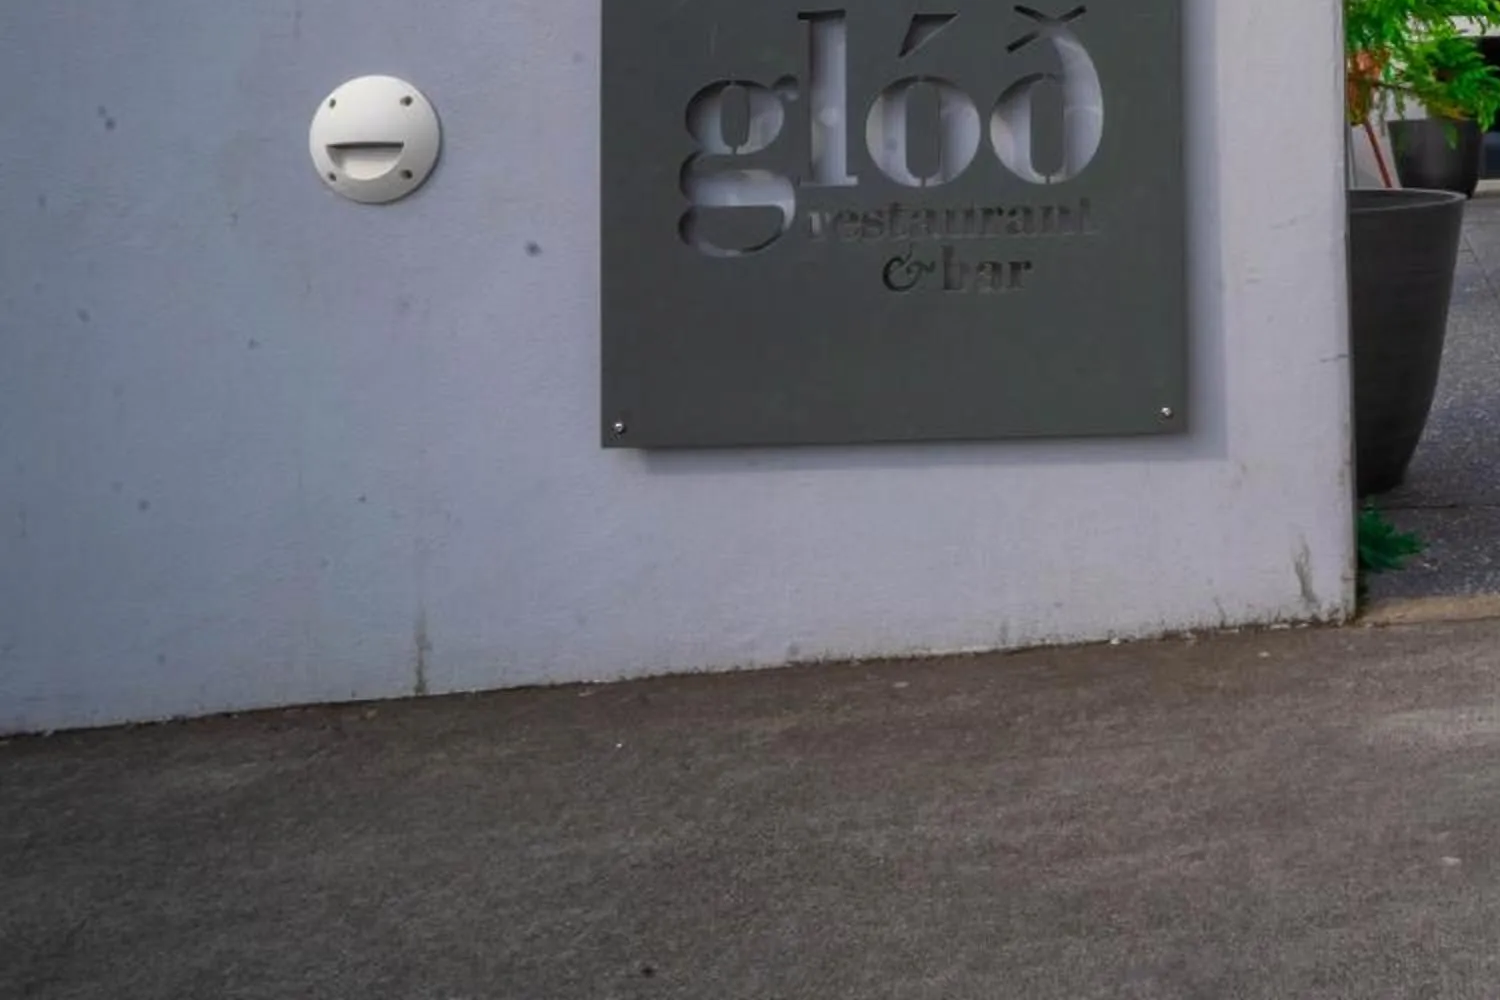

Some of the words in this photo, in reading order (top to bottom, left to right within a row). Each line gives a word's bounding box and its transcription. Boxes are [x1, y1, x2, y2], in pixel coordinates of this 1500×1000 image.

[677, 4, 1104, 258] glóð
[807, 198, 1097, 241] restaurant
[882, 244, 936, 293] &
[941, 245, 1033, 292] bar
